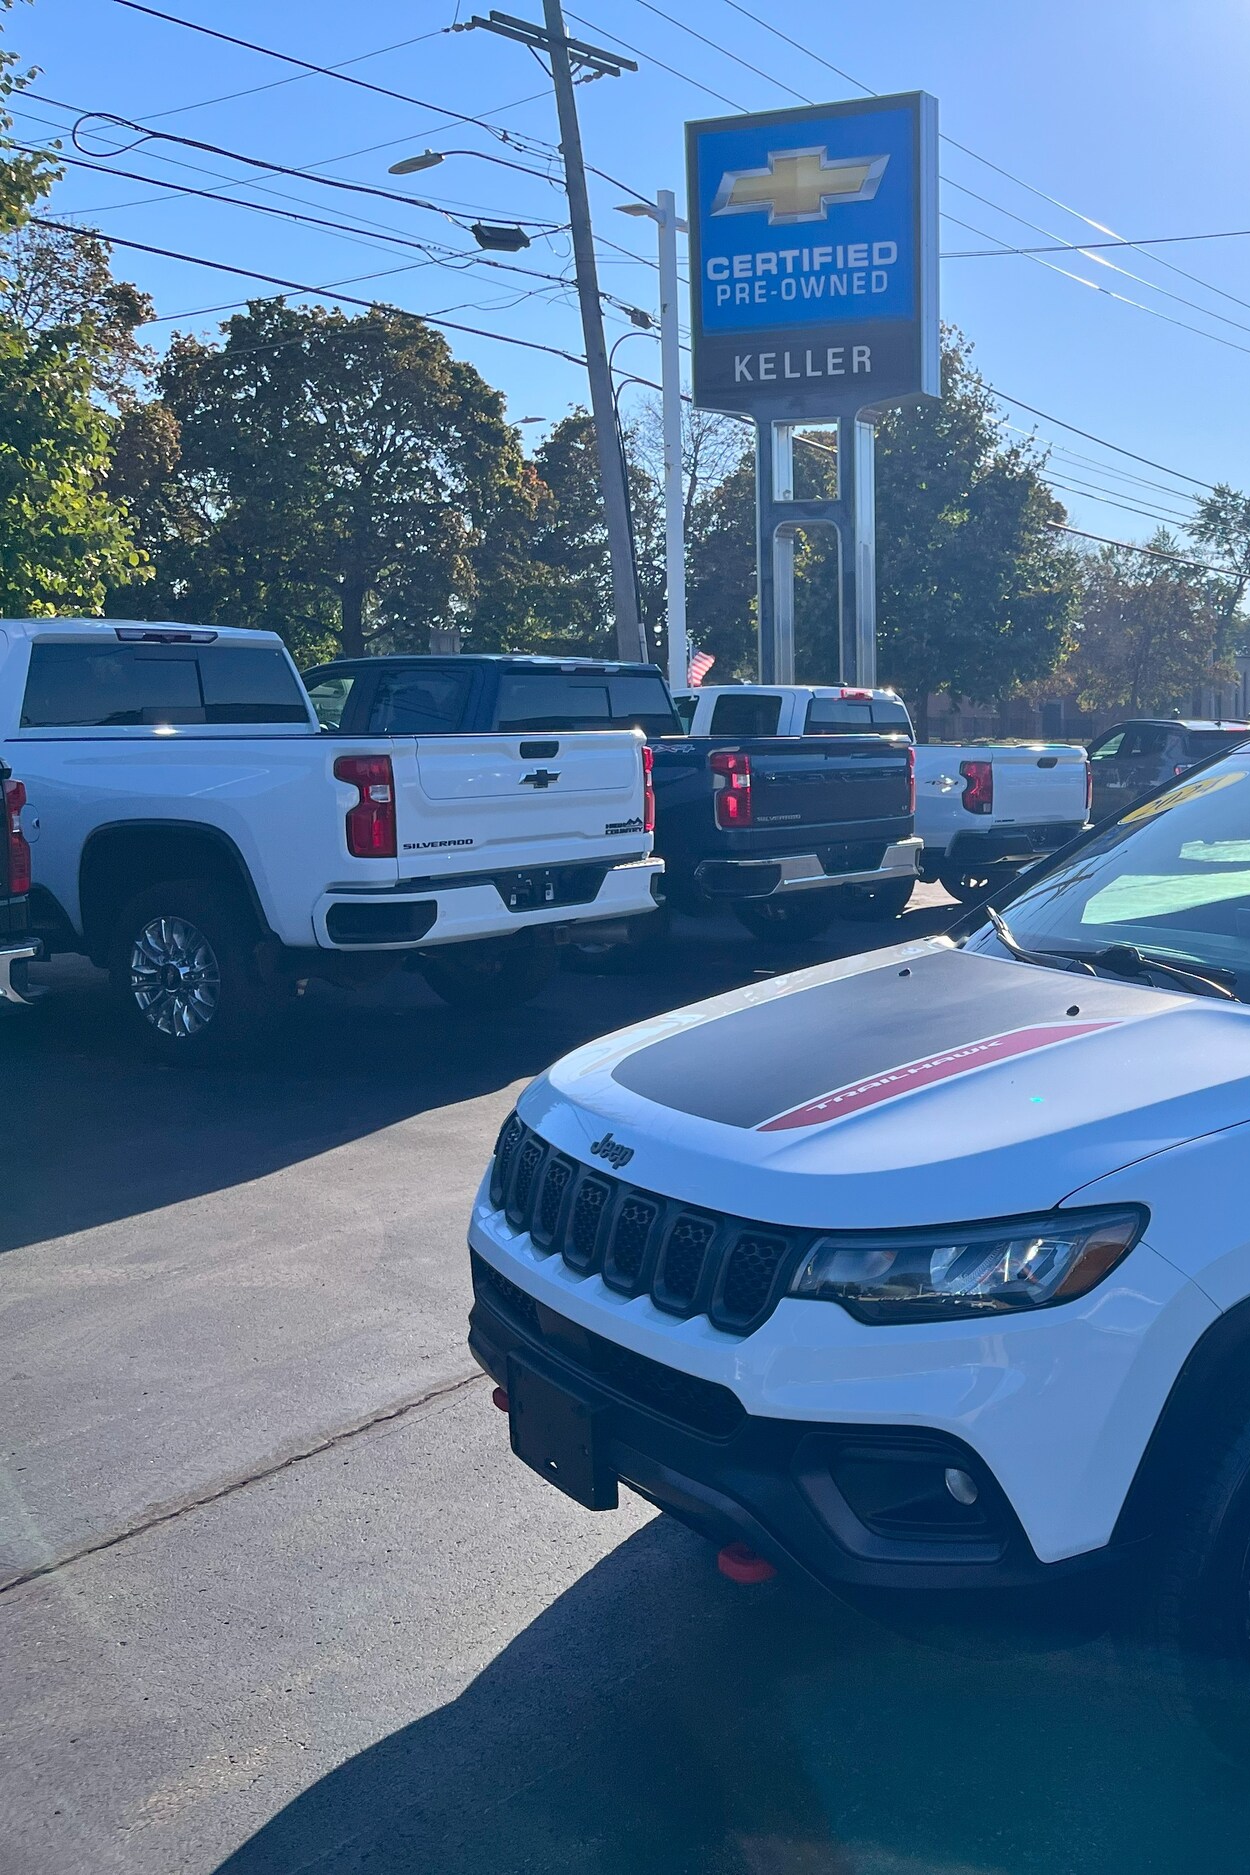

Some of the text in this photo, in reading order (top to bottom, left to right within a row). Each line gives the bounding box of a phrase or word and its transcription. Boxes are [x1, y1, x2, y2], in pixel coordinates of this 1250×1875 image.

[707, 241, 898, 281] CERTIFIED
[716, 270, 888, 306] PRE-OWNED
[734, 345, 872, 382] KELLER
[403, 838, 474, 850] SILVERADO
[804, 1039, 1004, 1112] TRAILHAWK
[590, 1132, 635, 1170] Jeep
